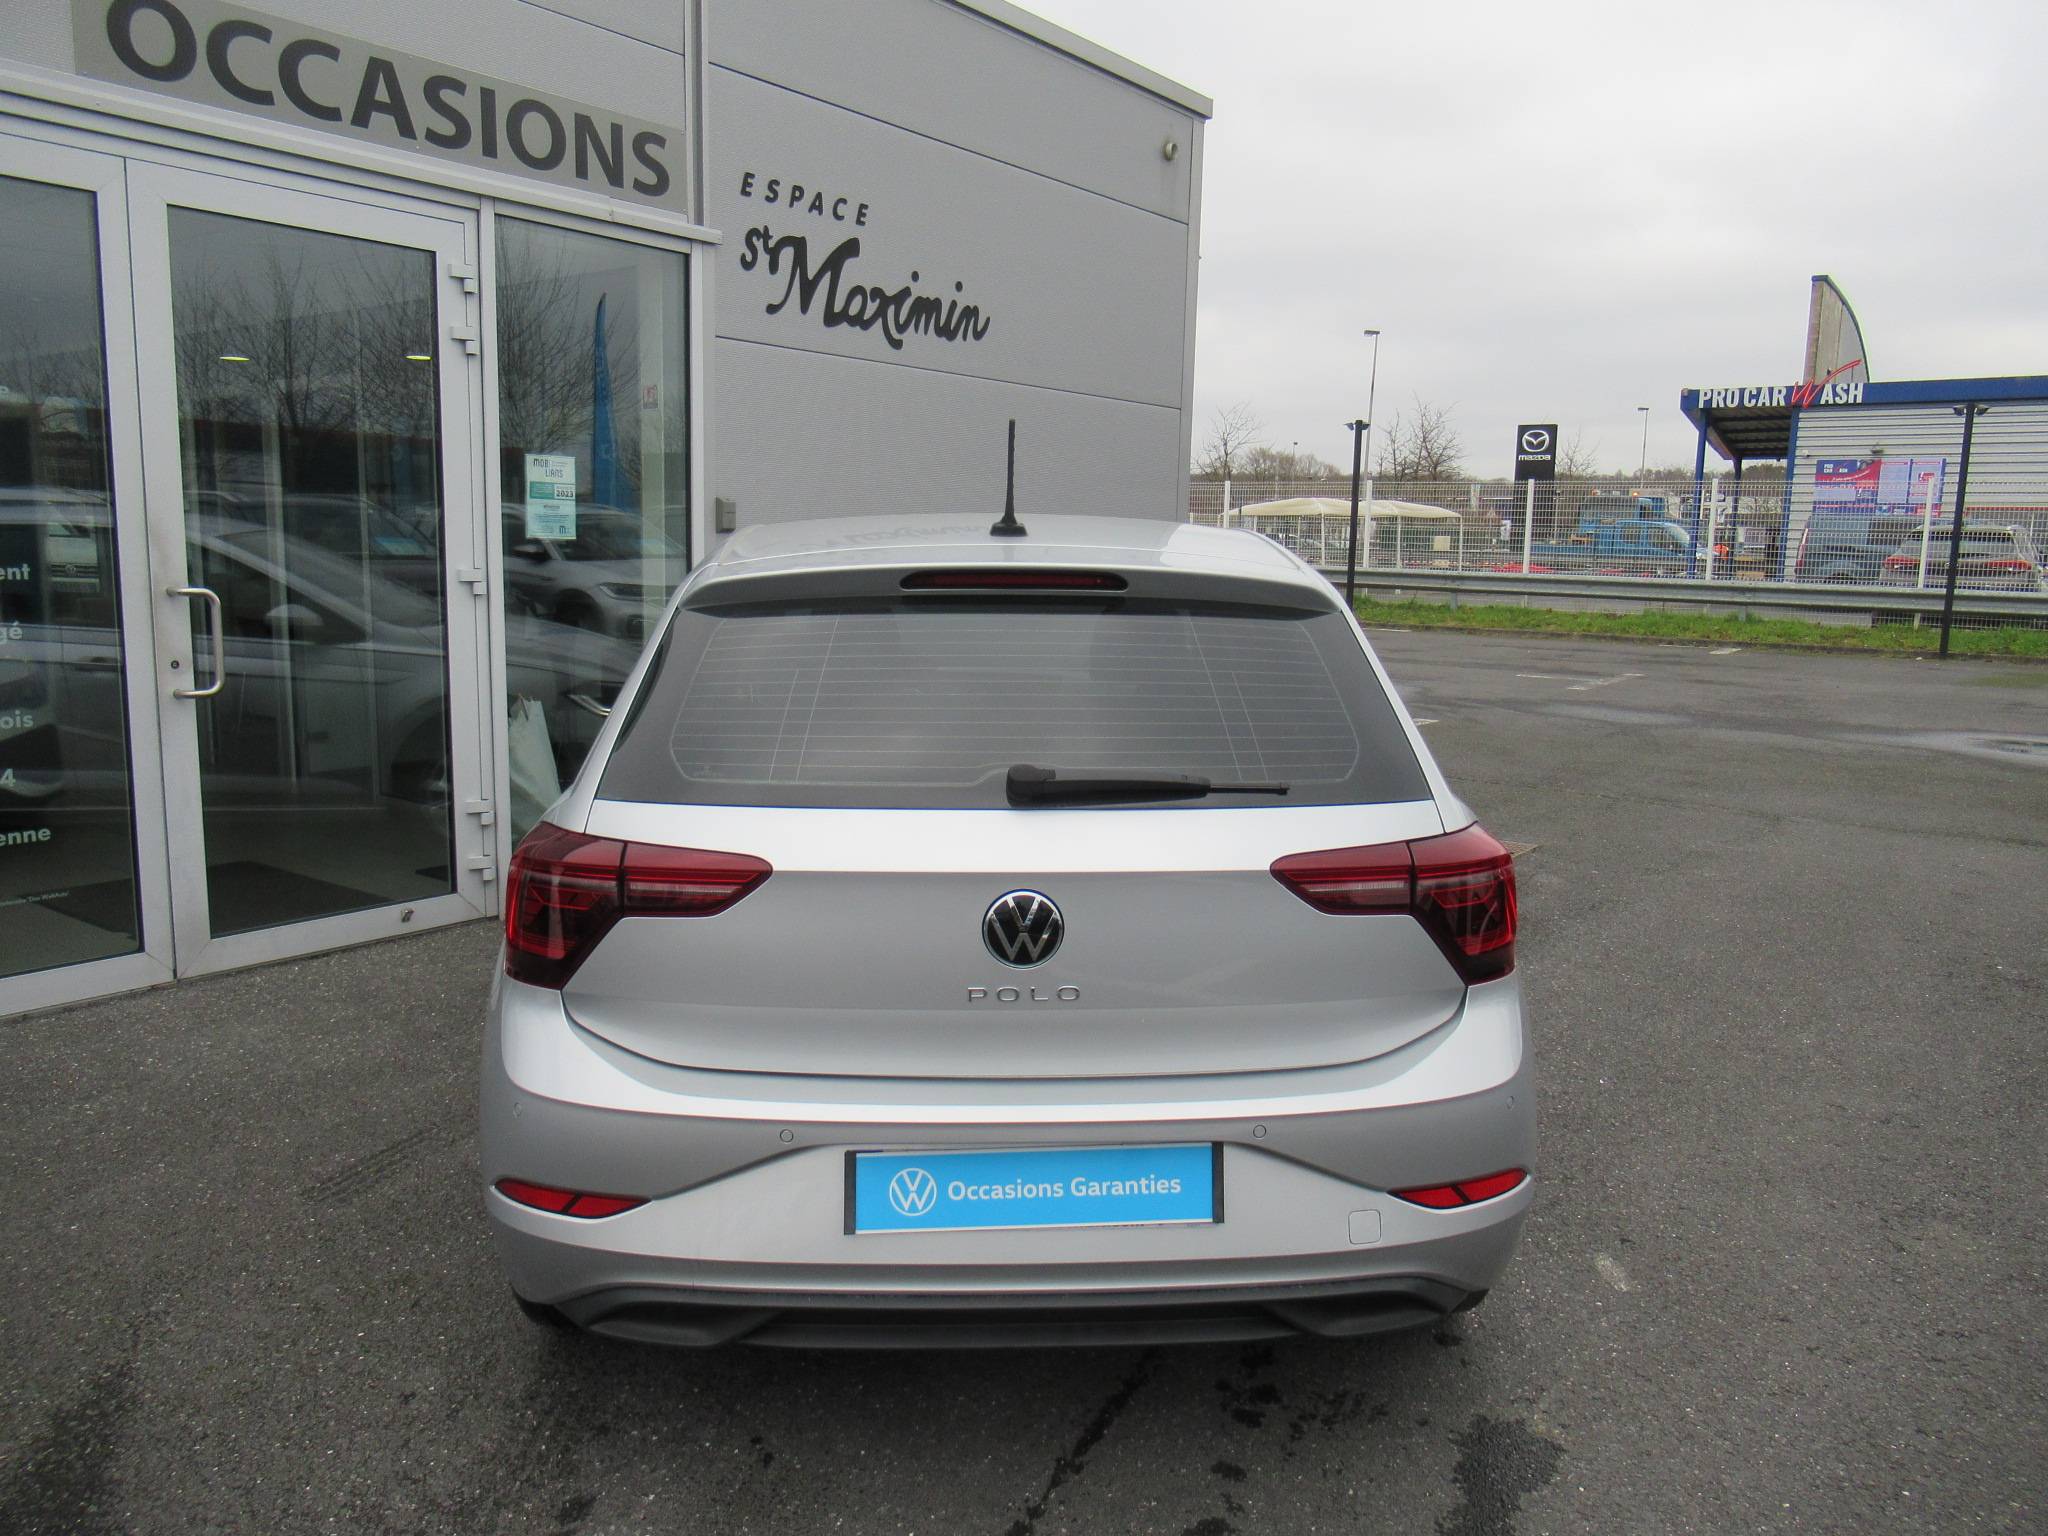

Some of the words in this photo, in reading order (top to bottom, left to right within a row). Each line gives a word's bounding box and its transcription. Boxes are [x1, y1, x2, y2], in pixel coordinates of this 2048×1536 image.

[105, 0, 671, 197] OCCASIONS
[740, 172, 869, 226] ESPACE
[766, 237, 990, 350] Maximin
[1699, 388, 1739, 409] PRO
[1744, 386, 1787, 408] CAR
[967, 985, 1081, 1002] POLO
[947, 1179, 1064, 1201] Occasions
[1070, 1174, 1182, 1197] Garanties
